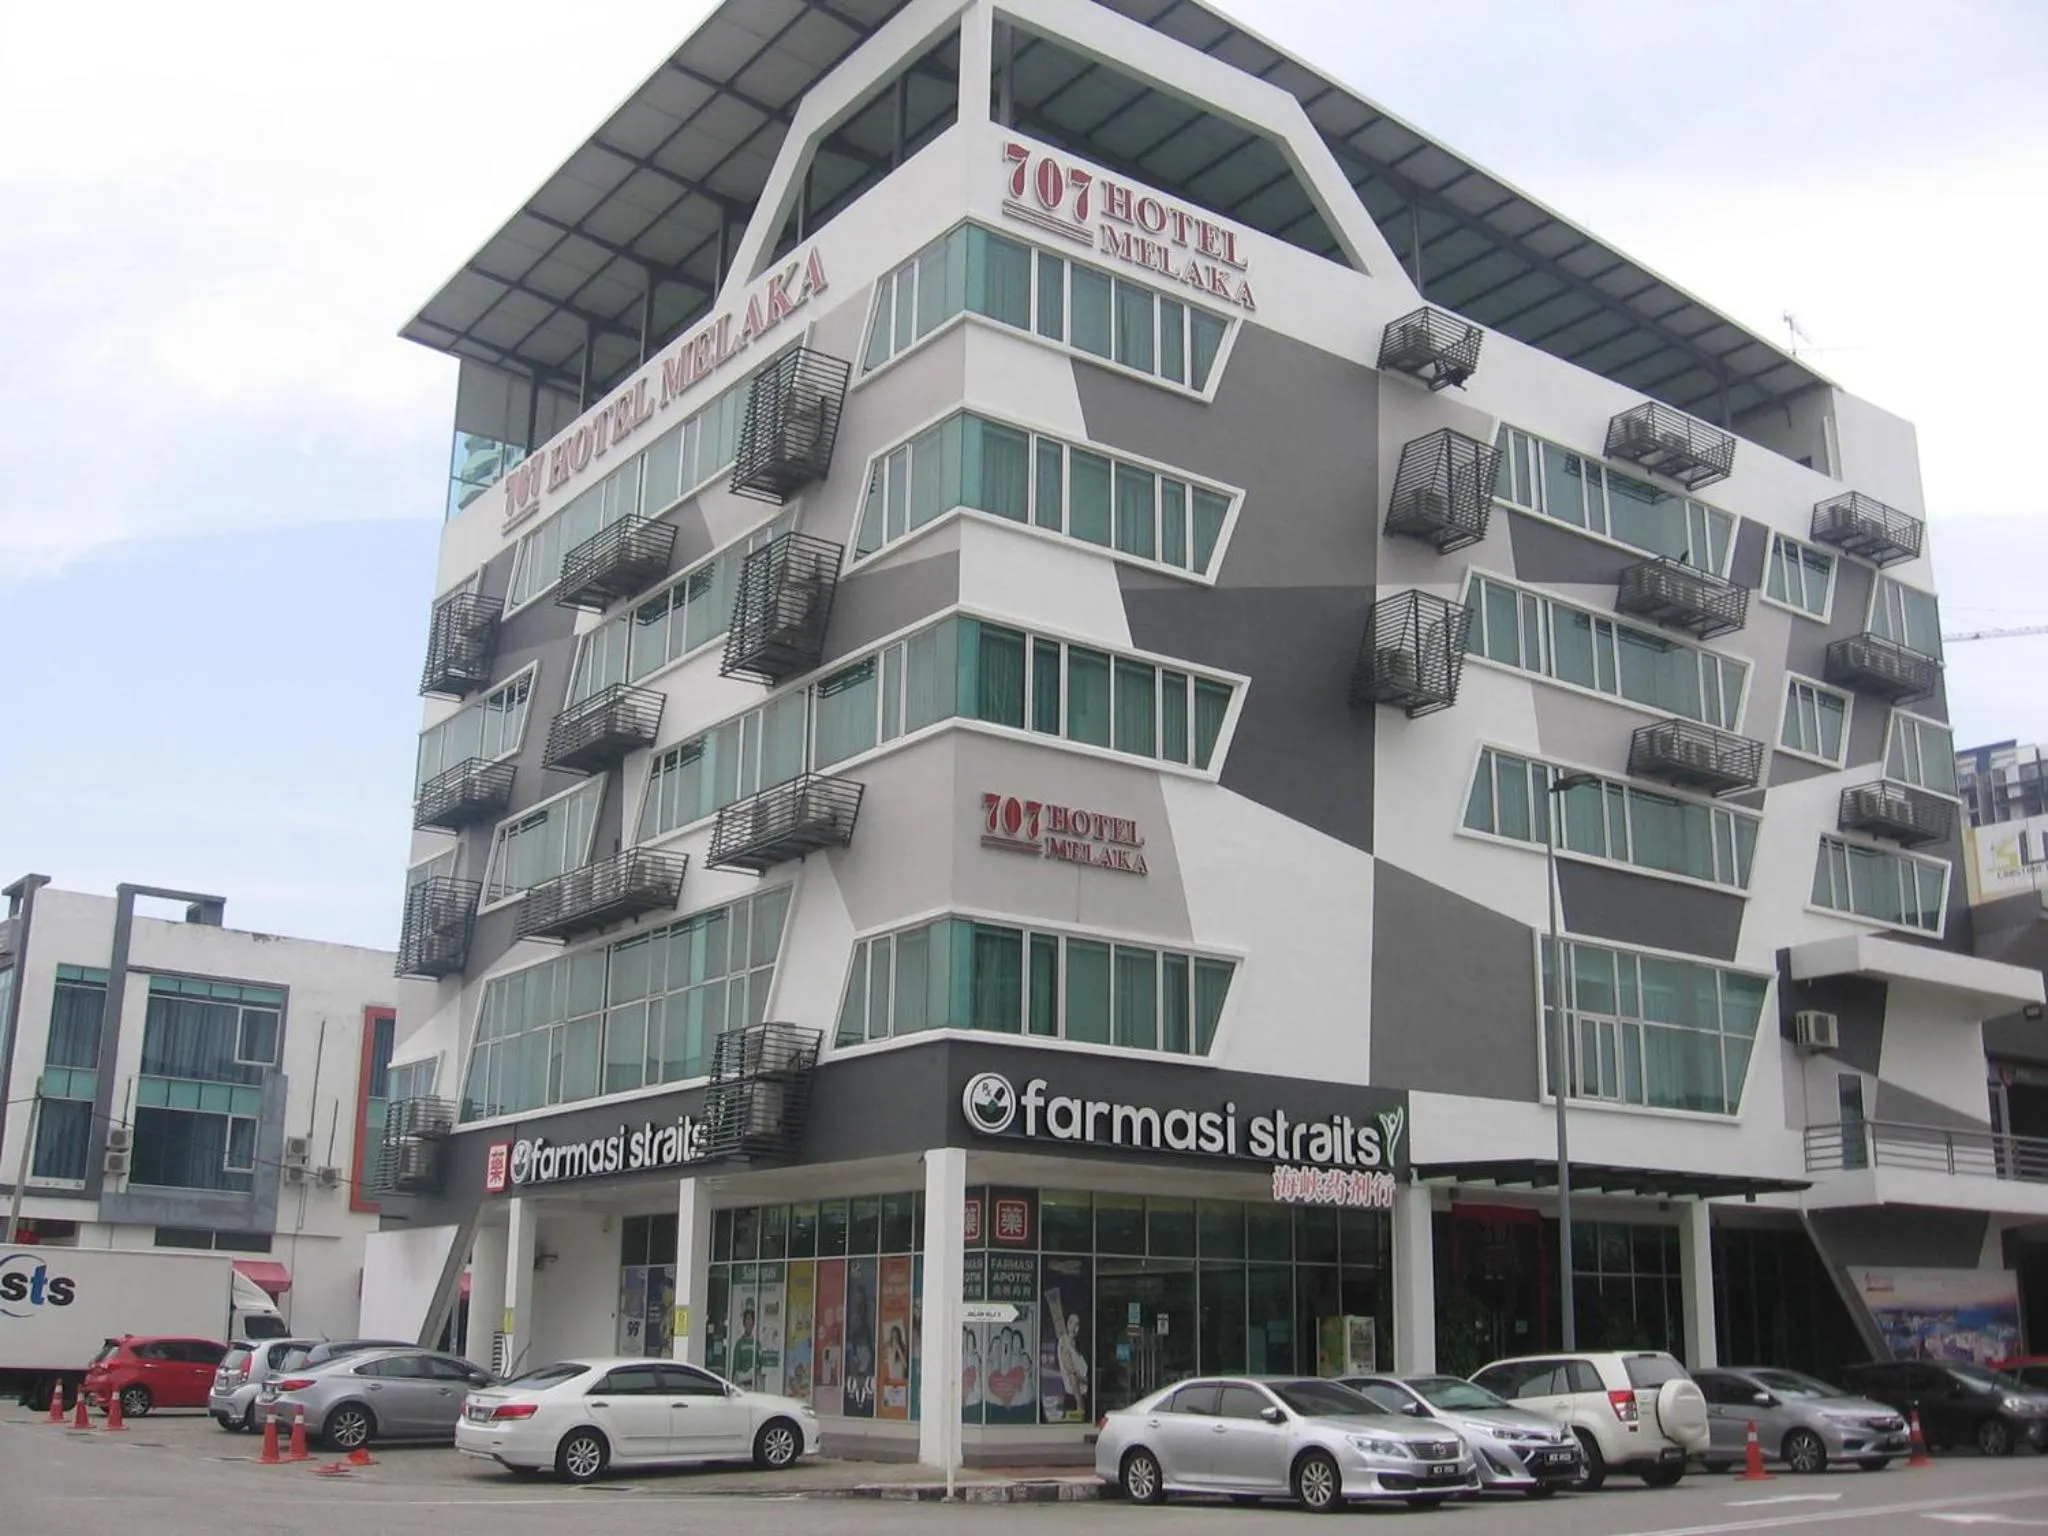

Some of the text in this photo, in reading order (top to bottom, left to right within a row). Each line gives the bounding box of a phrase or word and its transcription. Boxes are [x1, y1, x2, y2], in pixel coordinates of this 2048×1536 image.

[1003, 142, 1249, 272] 707 HOTEL
[1100, 223, 1257, 310] MELAKA
[503, 246, 829, 519] 707 HOTEL MELAKA
[981, 792, 1145, 848] 707 HOTEL
[1045, 837, 1148, 877] MELAKA
[529, 1115, 708, 1181] farmasi straits
[1020, 1078, 1382, 1167] farmasi straits
[0, 1264, 76, 1306] sts
[990, 1258, 1034, 1271] FARMASI
[993, 1271, 1033, 1284] APOTIK
